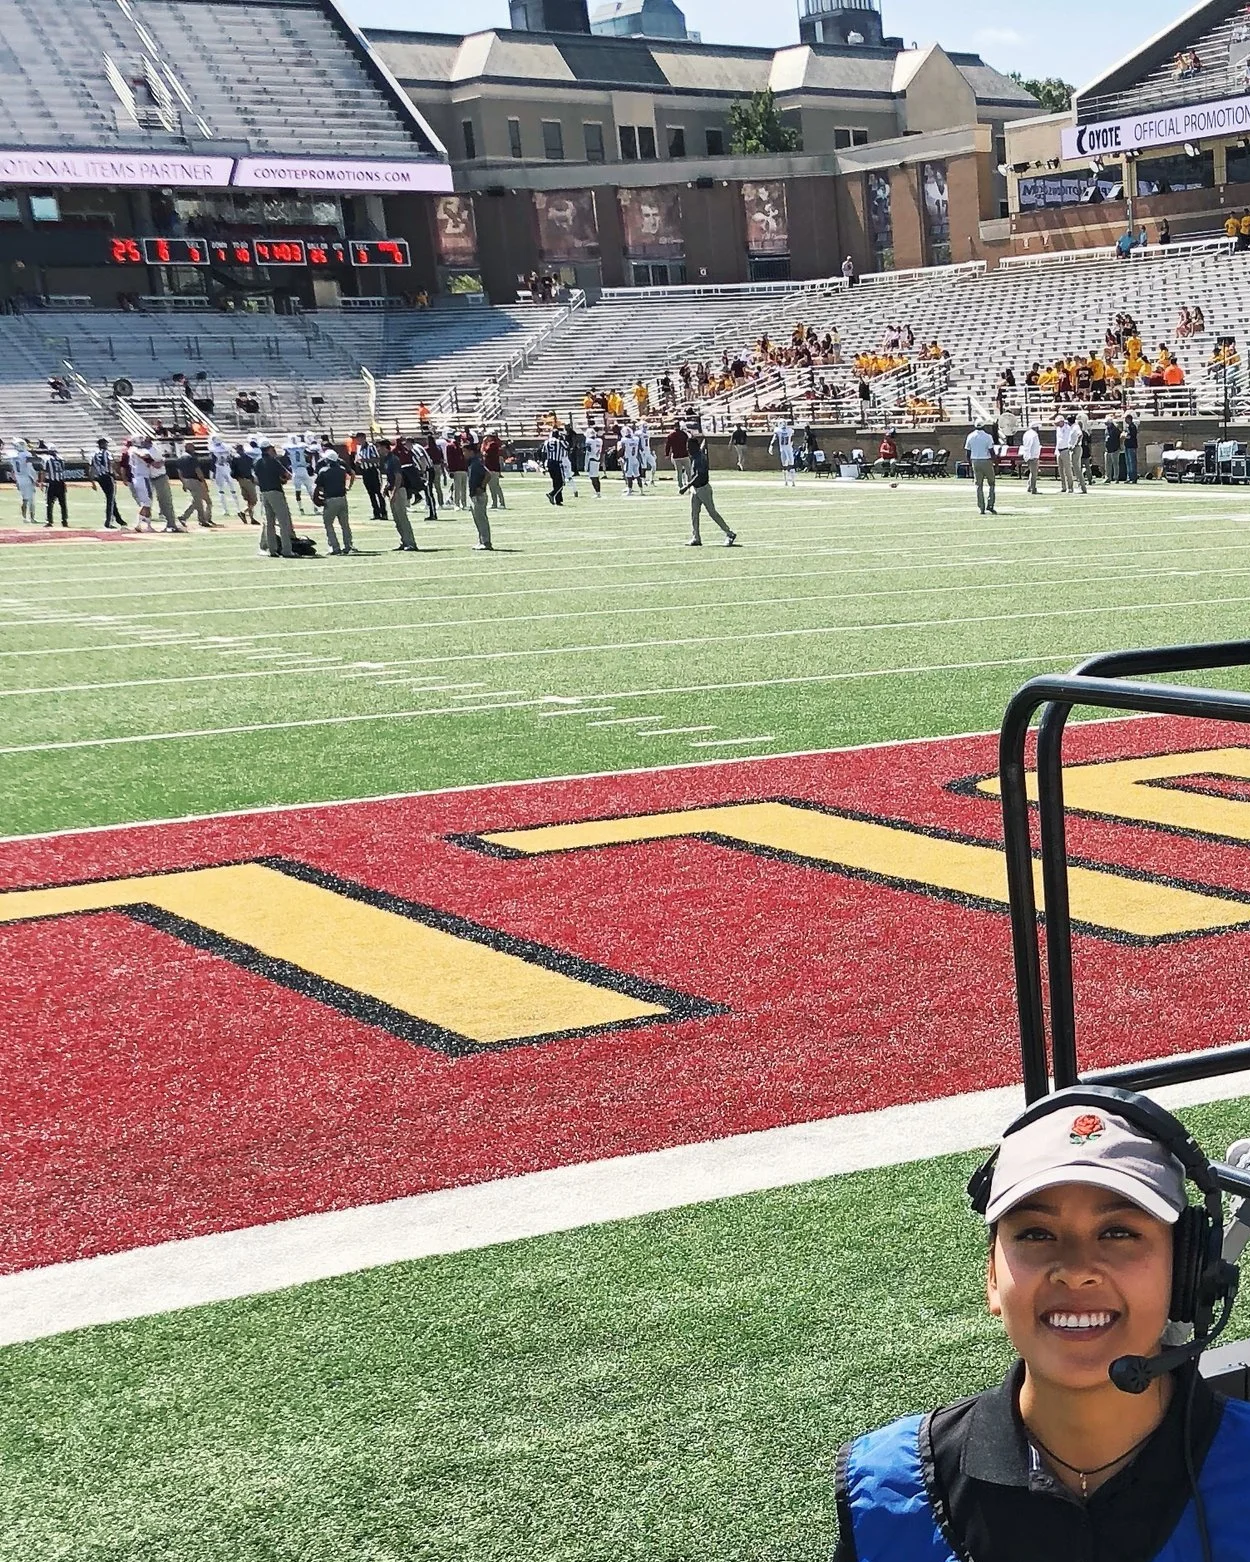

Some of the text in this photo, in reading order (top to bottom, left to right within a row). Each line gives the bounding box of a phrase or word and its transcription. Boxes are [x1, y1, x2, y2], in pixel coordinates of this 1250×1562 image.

[1076, 125, 1122, 155] COYOTE
[1134, 116, 1182, 141] OFFICIAL
[0, 158, 214, 181] OTIONAL ITEMS PARTNER
[253, 168, 411, 183] COYOTEPROMOTIONS.COM
